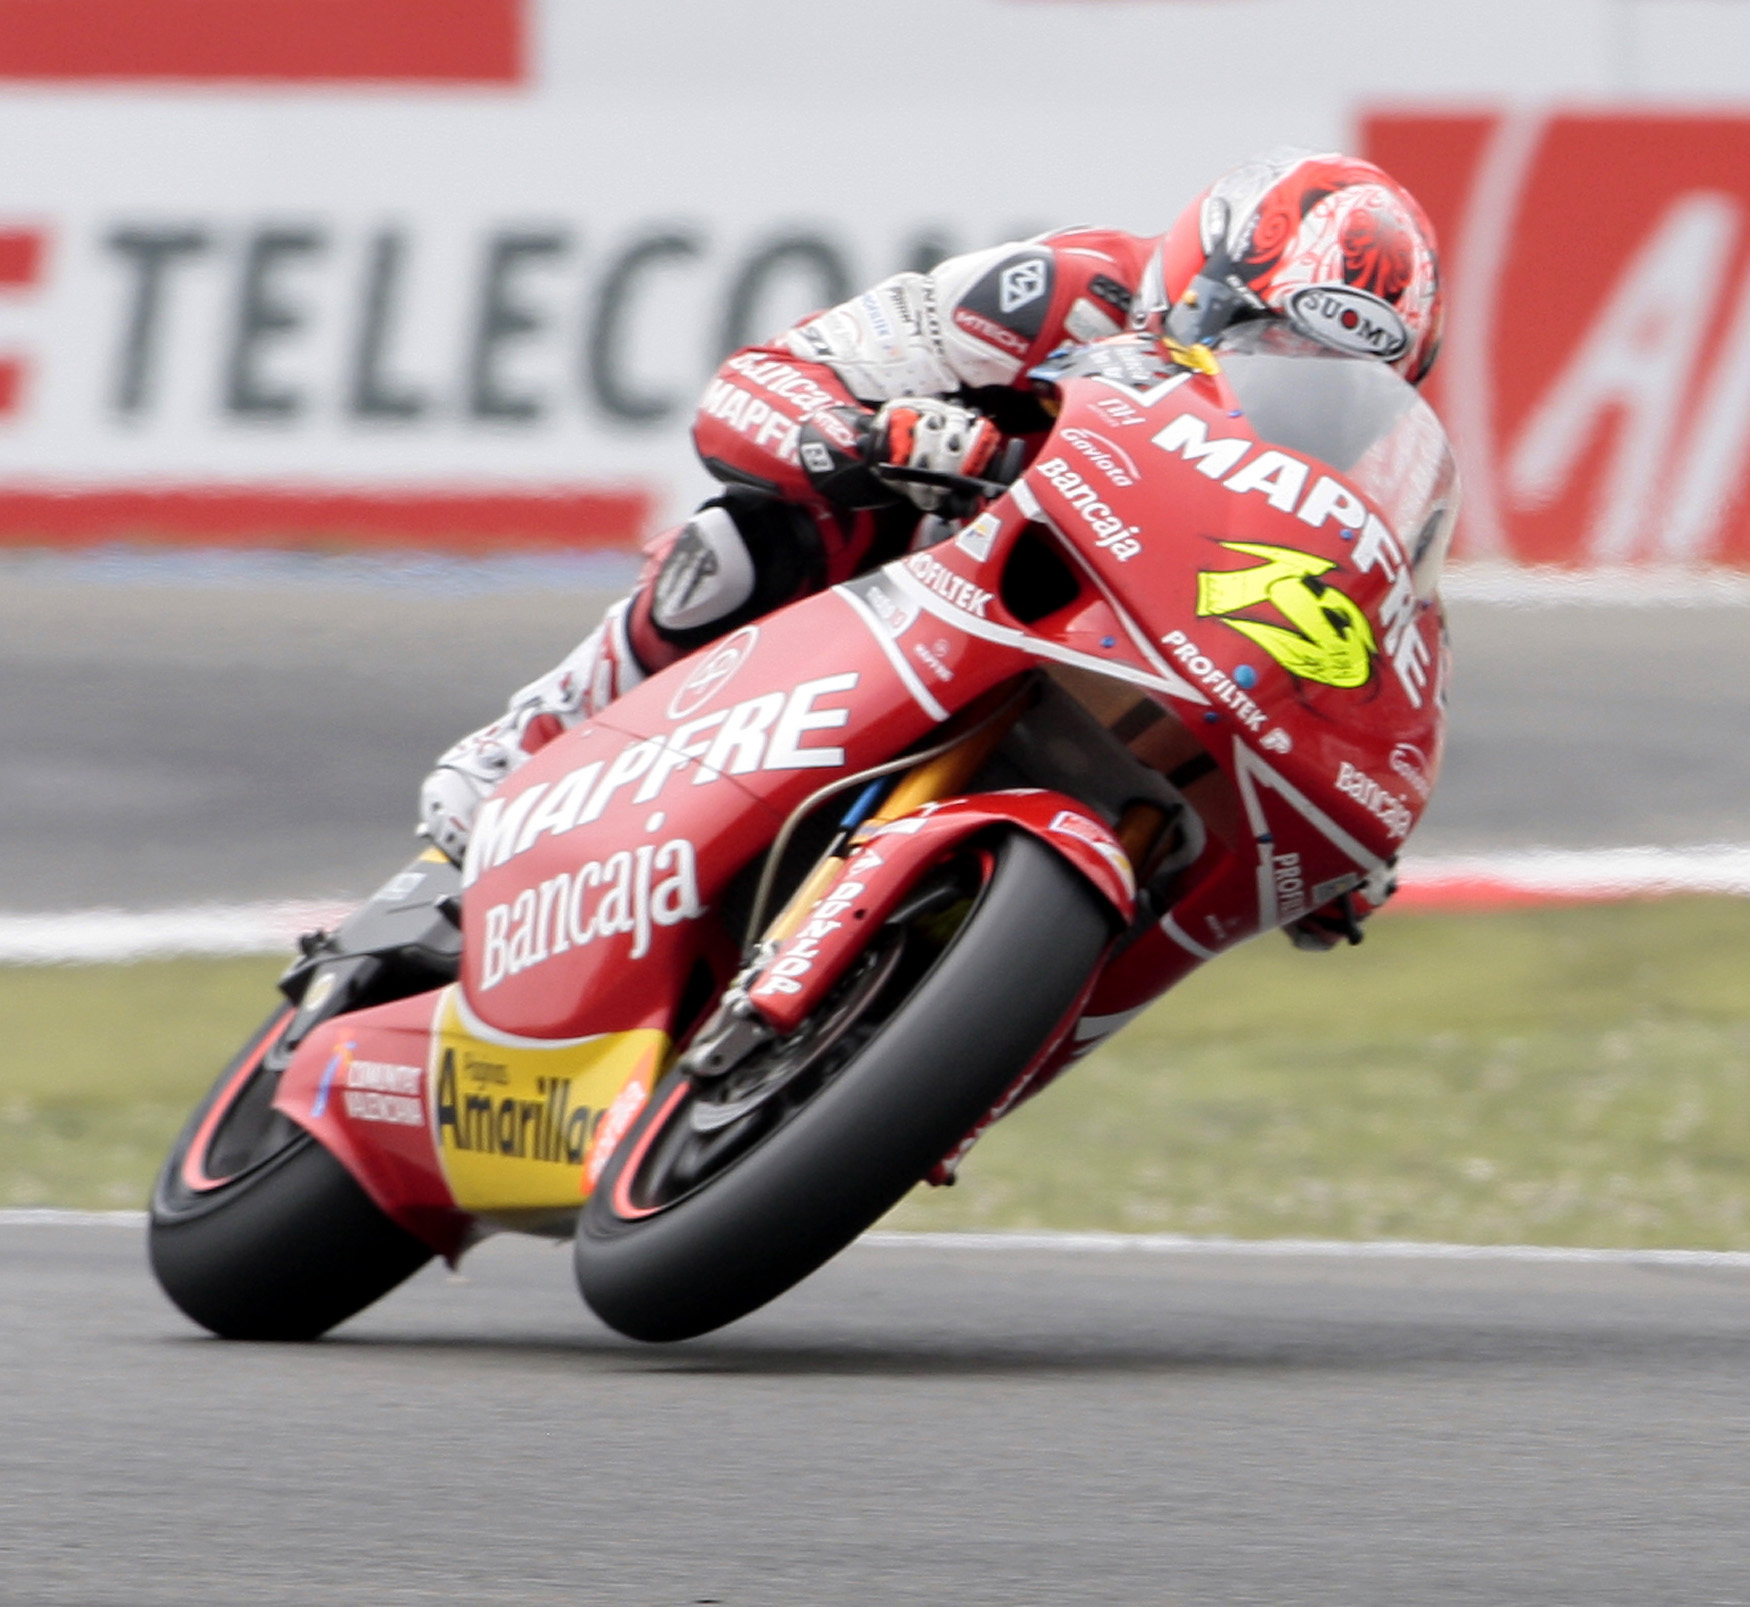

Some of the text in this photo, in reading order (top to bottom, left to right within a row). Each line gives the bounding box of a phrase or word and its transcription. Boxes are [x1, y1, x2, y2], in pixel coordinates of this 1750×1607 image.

[100, 222, 1005, 428] TELECO
[1303, 289, 1400, 357] SUOMY
[1036, 456, 1144, 563] Bancaja
[1151, 413, 1431, 709] MAPFRE
[1160, 629, 1269, 732] PROFILTEK
[461, 672, 860, 890] MAPFRE
[480, 811, 707, 992] Bancaja
[753, 881, 867, 995] DUNLOP
